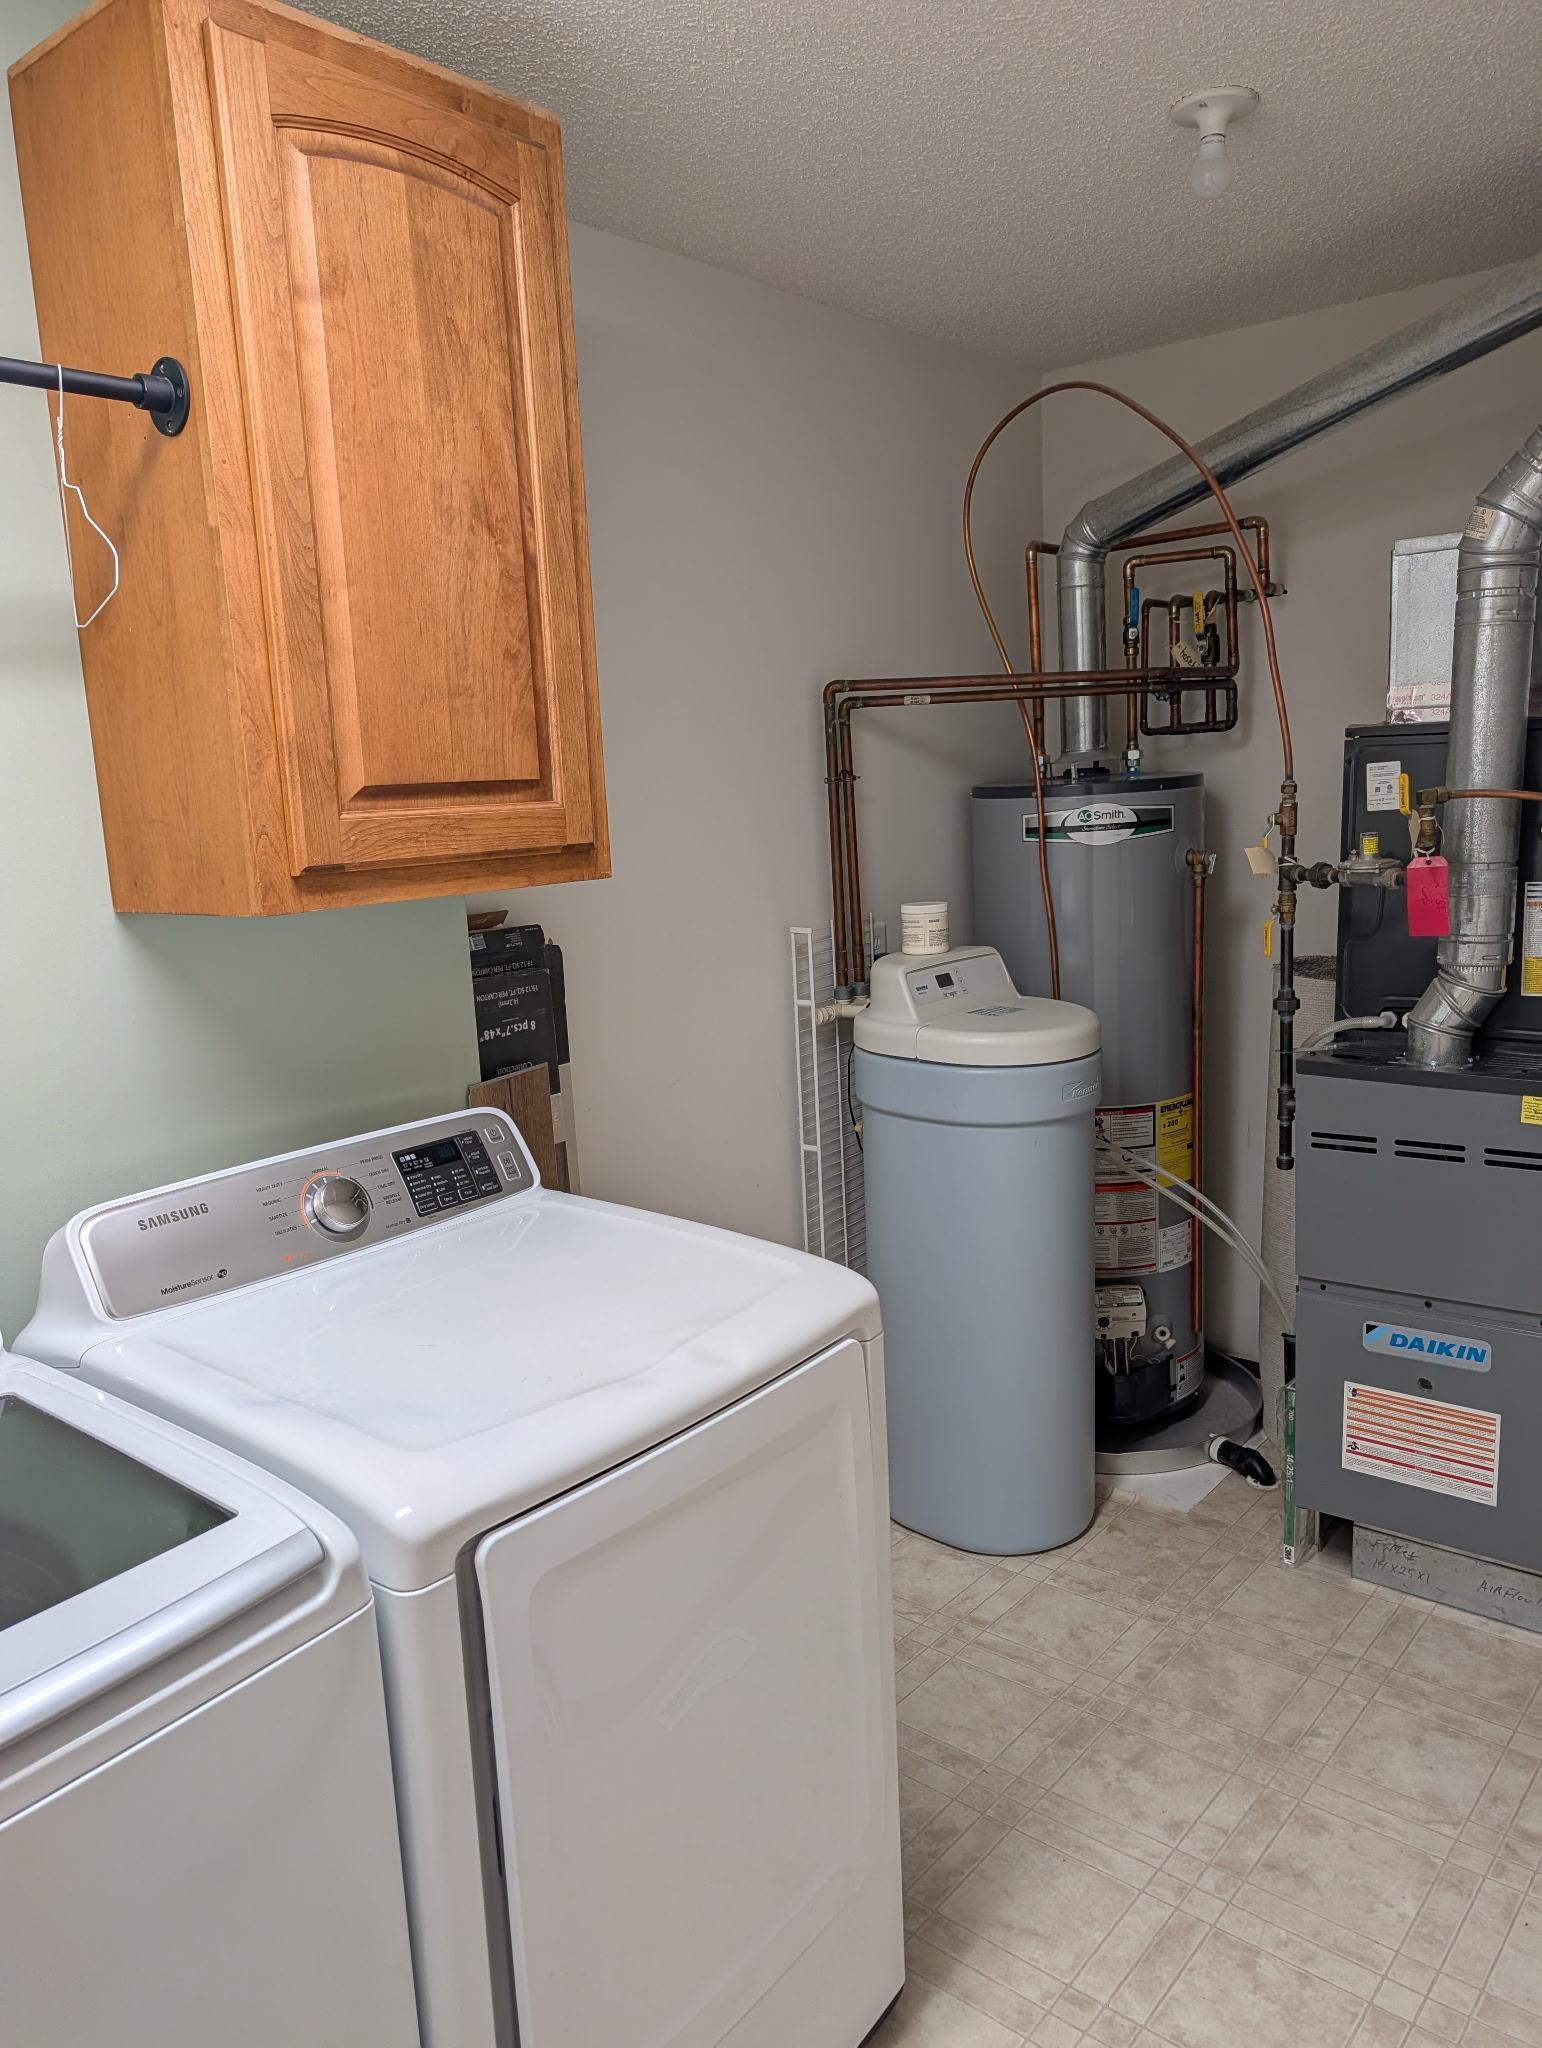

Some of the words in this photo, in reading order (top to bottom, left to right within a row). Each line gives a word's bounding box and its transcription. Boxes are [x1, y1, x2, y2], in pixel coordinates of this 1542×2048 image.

[1094, 810, 1124, 820] Smith
[476, 992, 498, 1003] CARTON
[137, 1202, 210, 1232] SAMSUNG
[160, 1274, 215, 1296] MoistureSensor
[1389, 1333, 1488, 1363] DAIKIN
